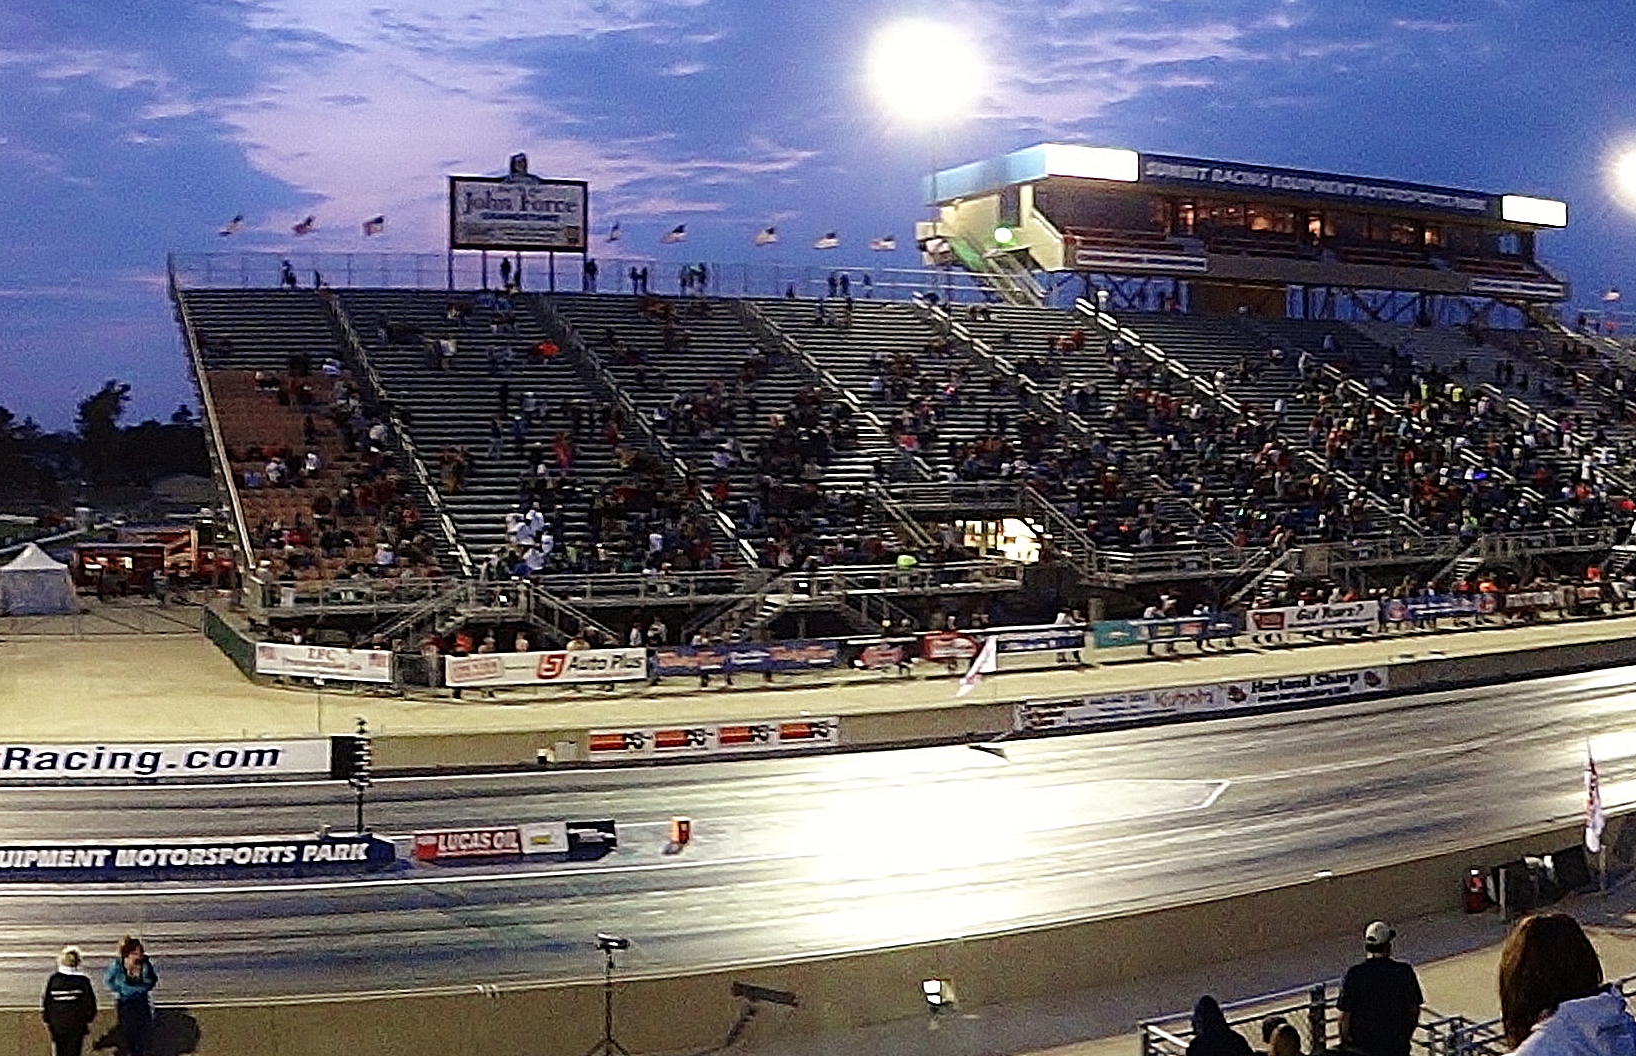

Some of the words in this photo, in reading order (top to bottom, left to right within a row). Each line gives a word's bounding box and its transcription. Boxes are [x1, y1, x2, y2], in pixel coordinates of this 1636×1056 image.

[567, 655, 607, 671] Auto
[610, 653, 644, 670] Plus
[437, 832, 492, 851] LUCAS
[492, 830, 519, 850] OIL
[114, 845, 299, 867] MOTORSPORTS
[301, 842, 370, 863] PARK
